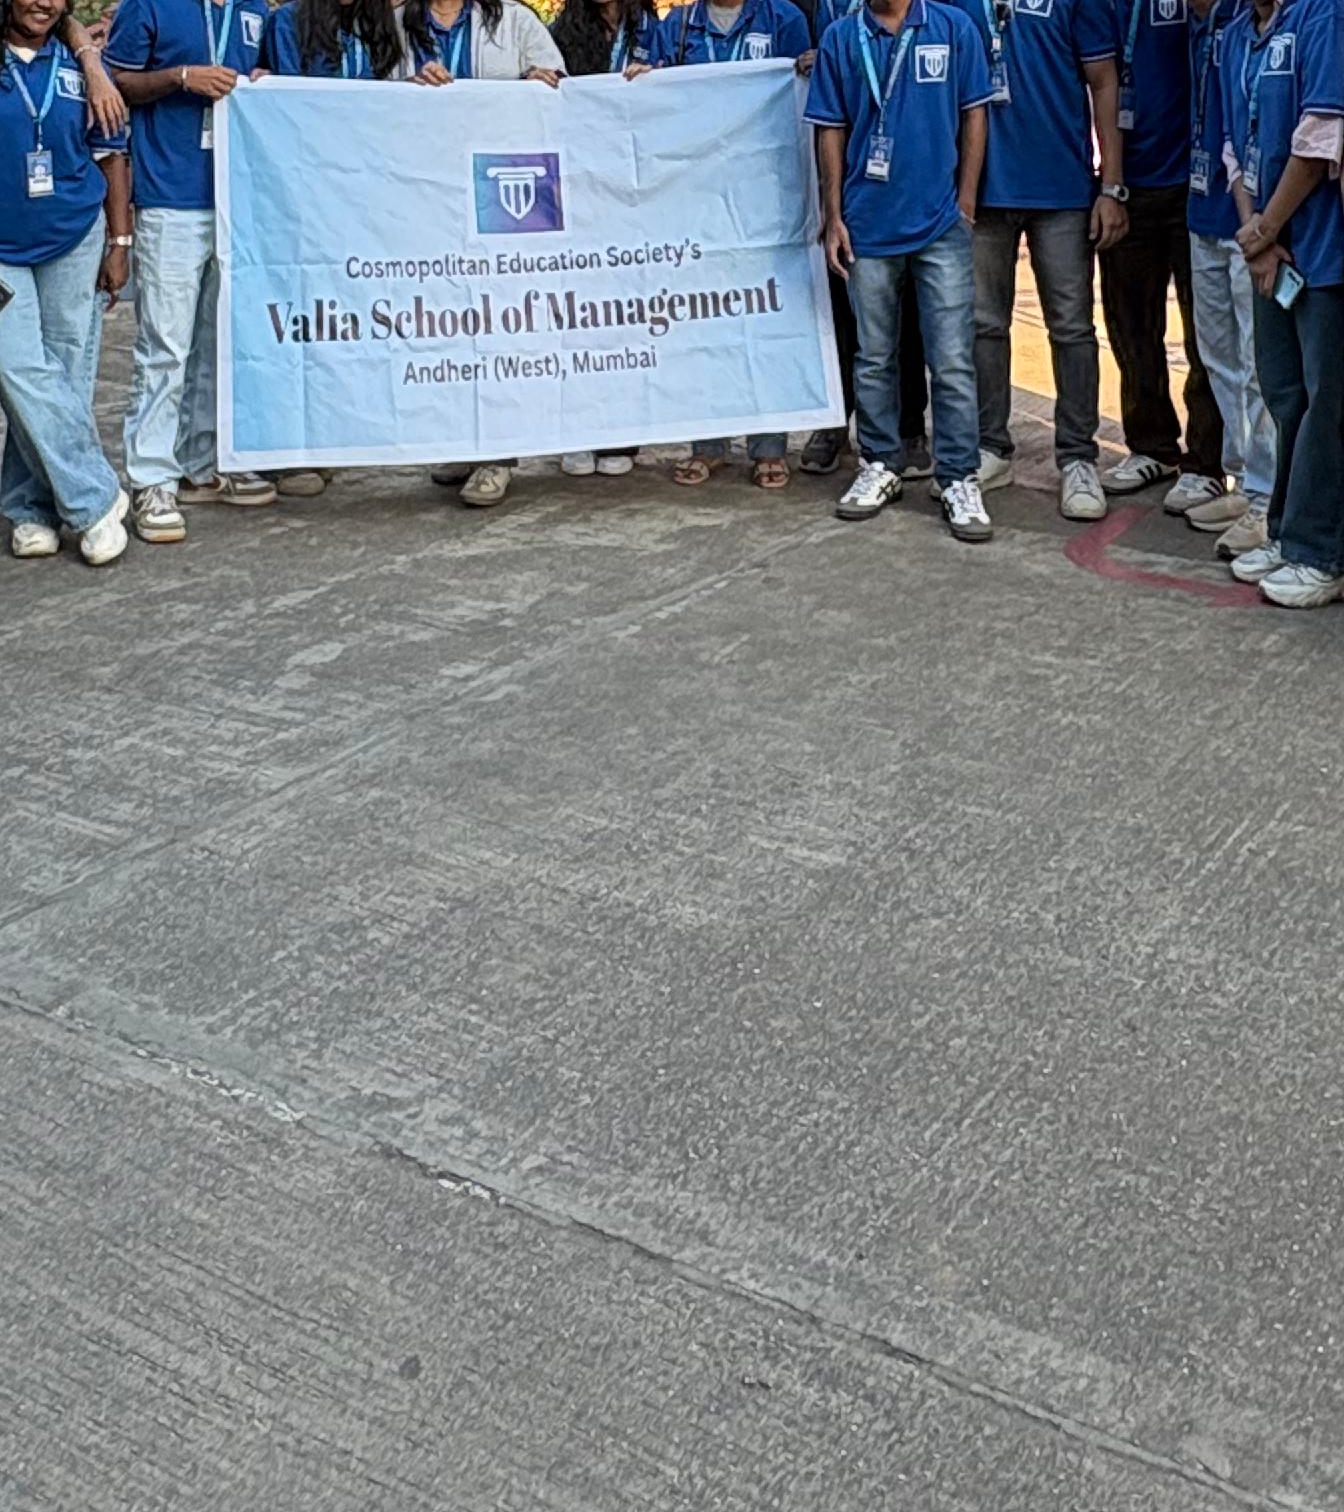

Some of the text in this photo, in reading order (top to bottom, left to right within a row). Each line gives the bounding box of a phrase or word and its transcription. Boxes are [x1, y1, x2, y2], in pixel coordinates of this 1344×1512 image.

[345, 238, 702, 283] Cosmopolitan Education Society's
[266, 276, 784, 344] Valia School of Management
[403, 345, 658, 385] Andheri (West), Mumbai
